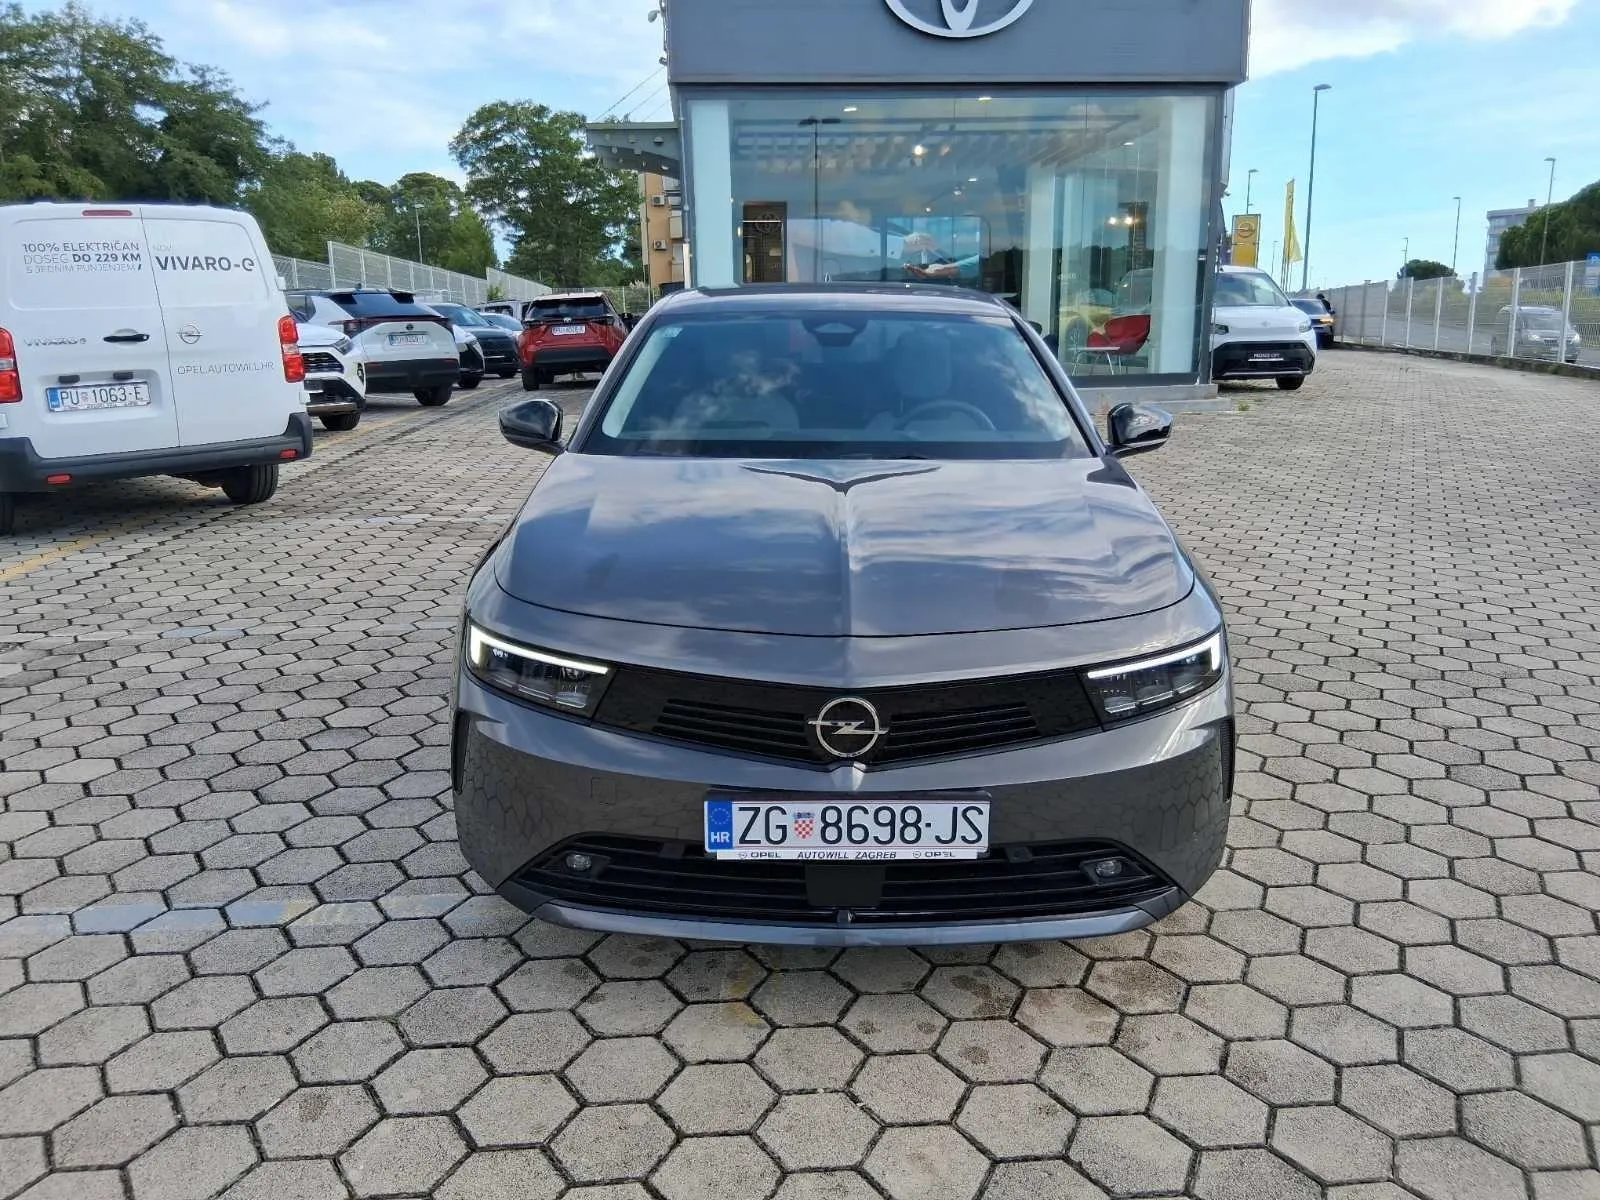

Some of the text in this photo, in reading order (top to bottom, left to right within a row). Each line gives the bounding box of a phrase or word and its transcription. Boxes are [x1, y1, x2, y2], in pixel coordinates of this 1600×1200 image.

[23, 243, 60, 253] 100%
[72, 253, 92, 263] DO
[95, 252, 119, 263] 229
[121, 252, 142, 262] KM
[155, 255, 255, 272] VIVARO-e
[60, 391, 79, 405] PU
[738, 805, 788, 845] ZG
[710, 831, 730, 843] HR
[797, 851, 849, 860] AUTOWILL
[855, 851, 897, 860] ZAGREB
